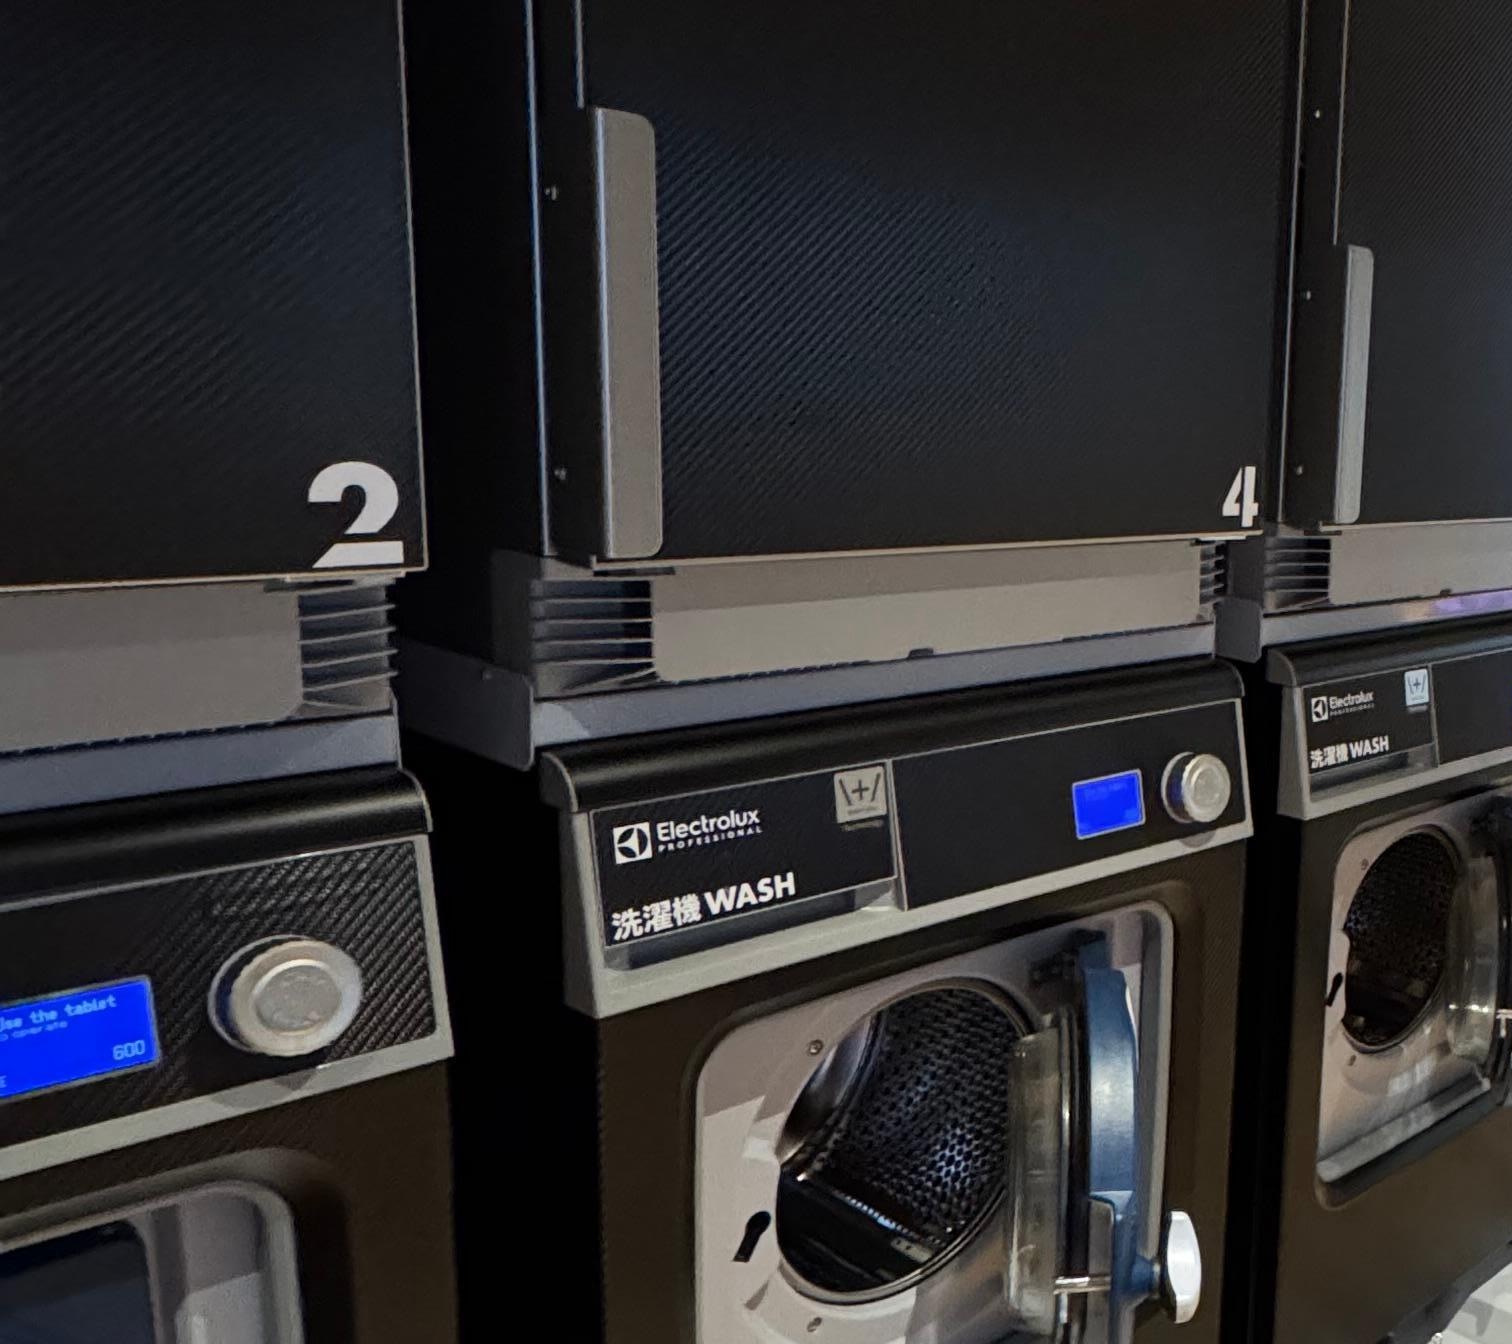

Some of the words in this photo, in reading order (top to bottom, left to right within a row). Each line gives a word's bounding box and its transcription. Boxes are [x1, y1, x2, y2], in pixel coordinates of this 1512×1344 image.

[1222, 465, 1259, 528] 4
[307, 460, 405, 569] 2
[1329, 690, 1374, 710] Electrolux
[1349, 735, 1390, 759] WASH
[656, 808, 761, 842] Electrolux
[658, 825, 763, 852] PROFESSIONAL
[611, 893, 702, 941] 洗濯機
[703, 871, 796, 916] WASH
[29, 1009, 58, 1024] the
[64, 994, 118, 1017] tablet
[113, 1040, 146, 1061] 600
